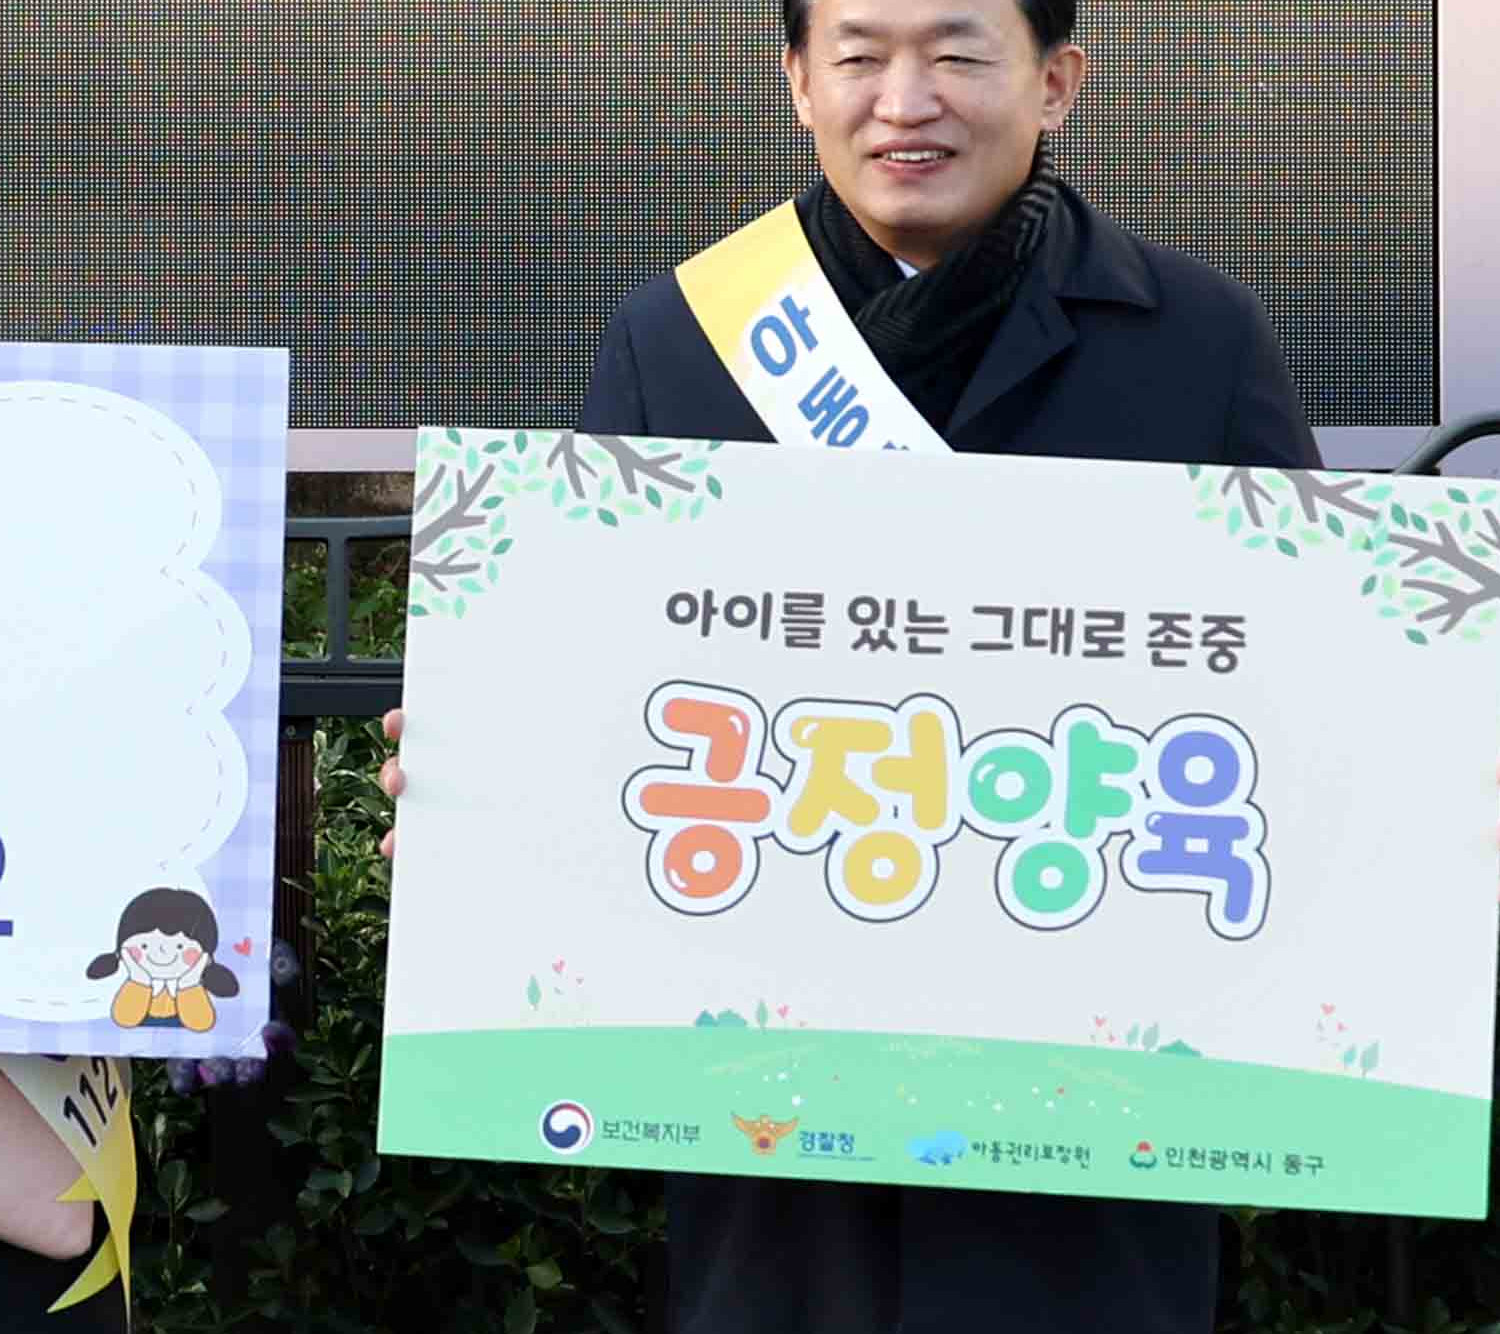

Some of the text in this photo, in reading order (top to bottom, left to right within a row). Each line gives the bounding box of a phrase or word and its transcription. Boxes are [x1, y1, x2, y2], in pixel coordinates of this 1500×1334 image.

[749, 293, 906, 451] 아동
[664, 589, 1249, 674] 아이를 있는 그대로 존중
[632, 689, 1262, 931] 긍정양육
[63, 1055, 118, 1148] 112
[601, 1119, 701, 1146] 보건복지부
[799, 1130, 856, 1155] 경찰청
[1165, 1146, 1326, 1178] 인천광역시 동구
